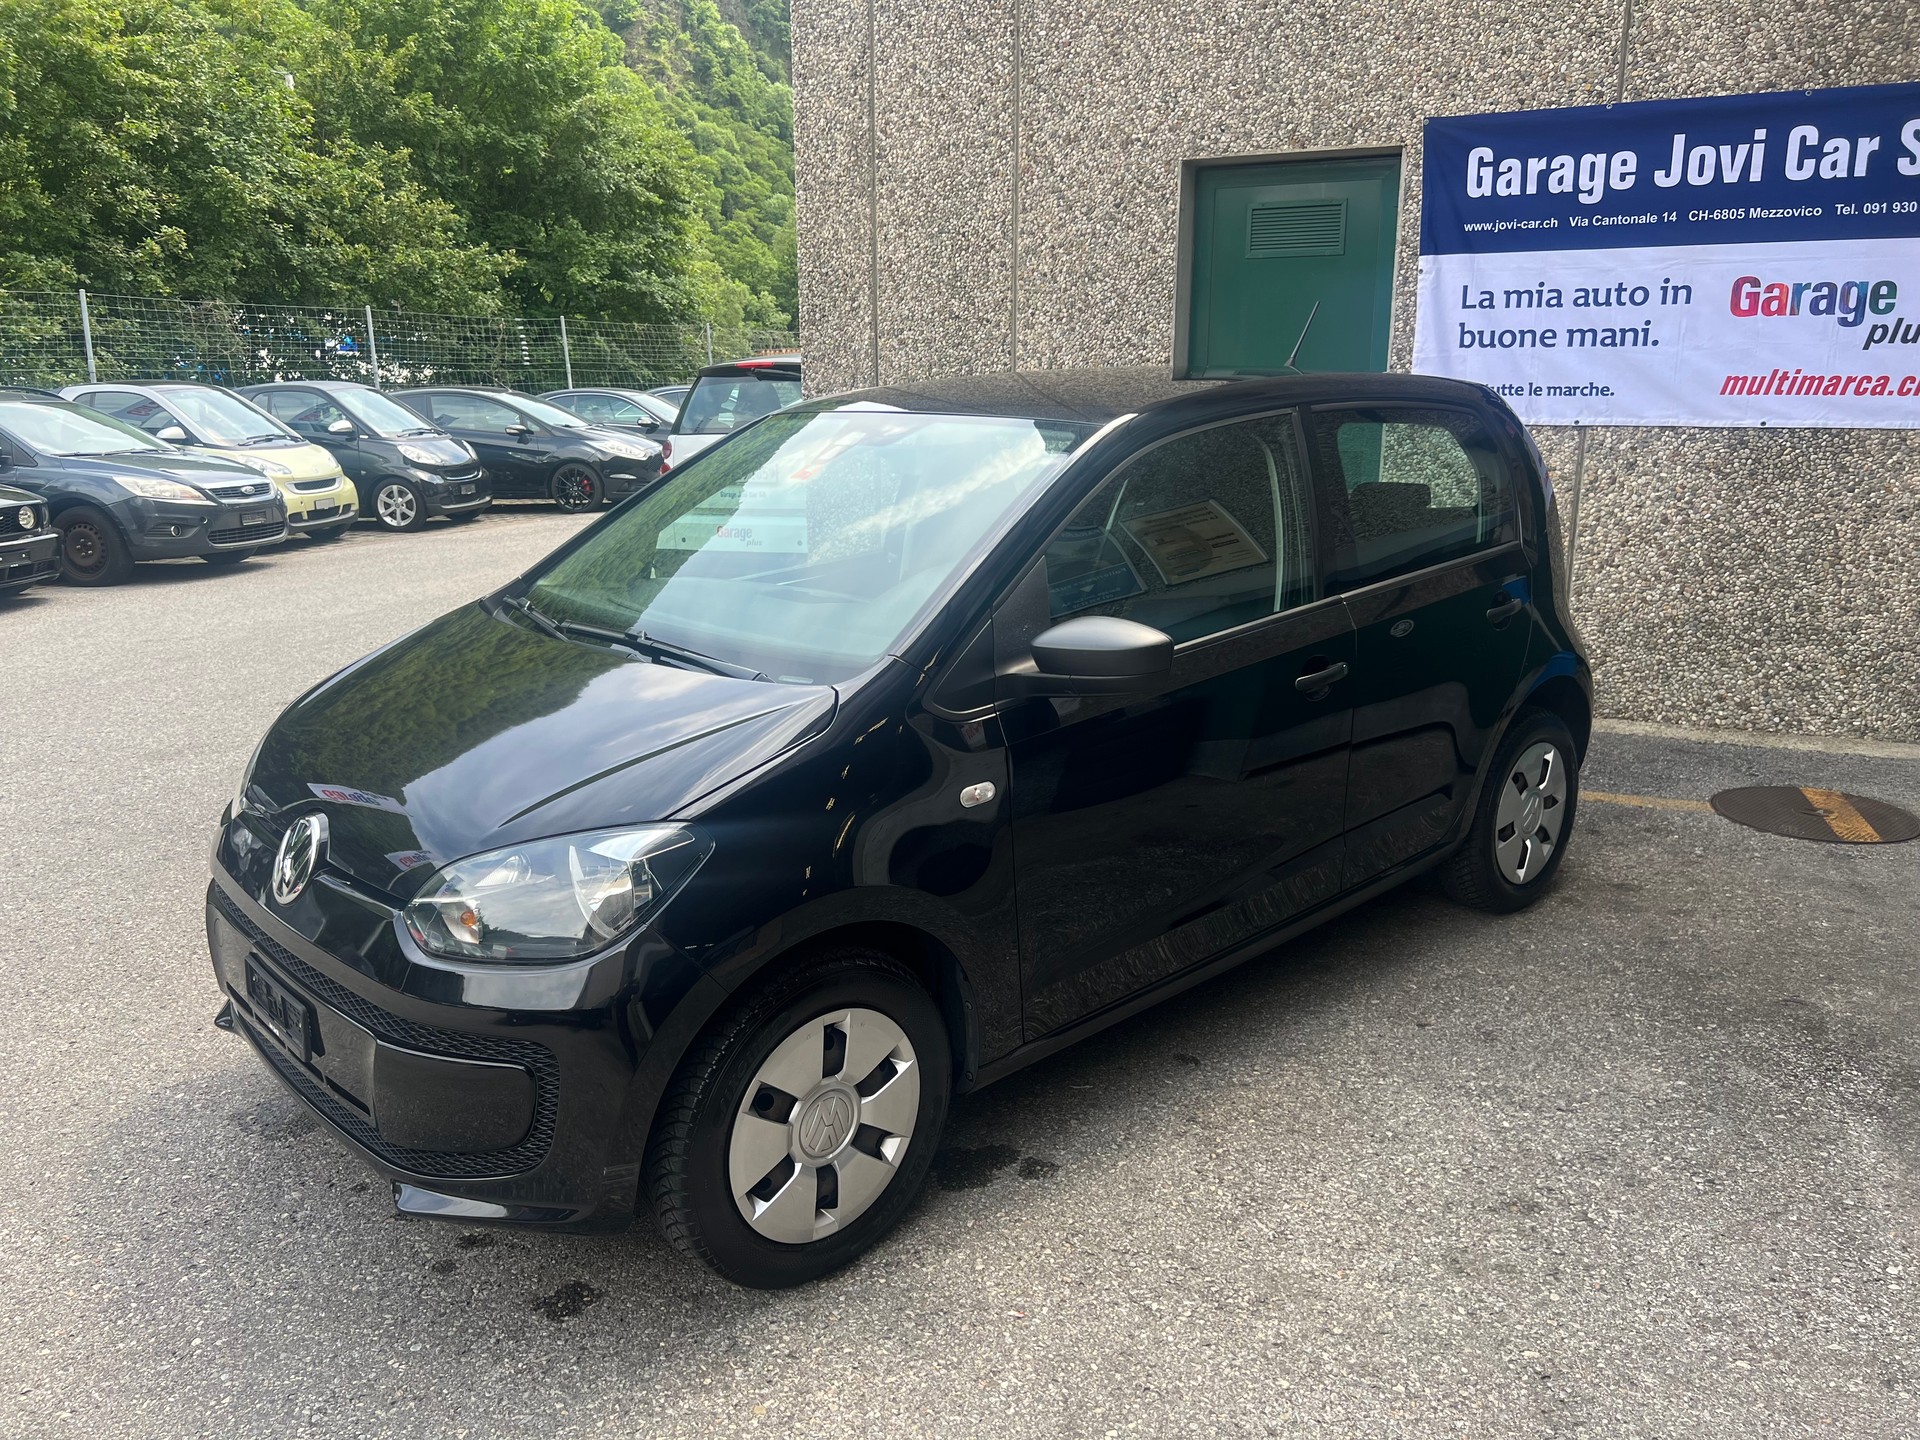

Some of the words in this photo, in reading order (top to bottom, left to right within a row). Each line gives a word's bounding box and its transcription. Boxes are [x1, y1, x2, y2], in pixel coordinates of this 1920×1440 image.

[1466, 146, 1638, 205] Garage
[1653, 128, 1767, 188] Jovi
[1784, 124, 1881, 181] Car
[1464, 217, 1558, 233] www.jovi-car.ch
[1569, 214, 1589, 227] Via
[1592, 212, 1658, 226] Cantonale
[1662, 211, 1678, 223] 14
[1688, 208, 1745, 222] CH-6805
[1749, 205, 1823, 219] Mezzovico
[1835, 203, 1859, 216] Tel.
[1863, 202, 1887, 215] 091
[1892, 201, 1918, 213] 930
[1461, 284, 1496, 310] La
[1503, 281, 1564, 309] mia
[1572, 281, 1650, 308] auto
[1660, 277, 1693, 306] in
[1730, 275, 1898, 328] Garage
[1458, 322, 1558, 349] buone
[1566, 319, 1660, 348] mani.
[1528, 382, 1543, 396] le
[1546, 382, 1615, 396] marche.
